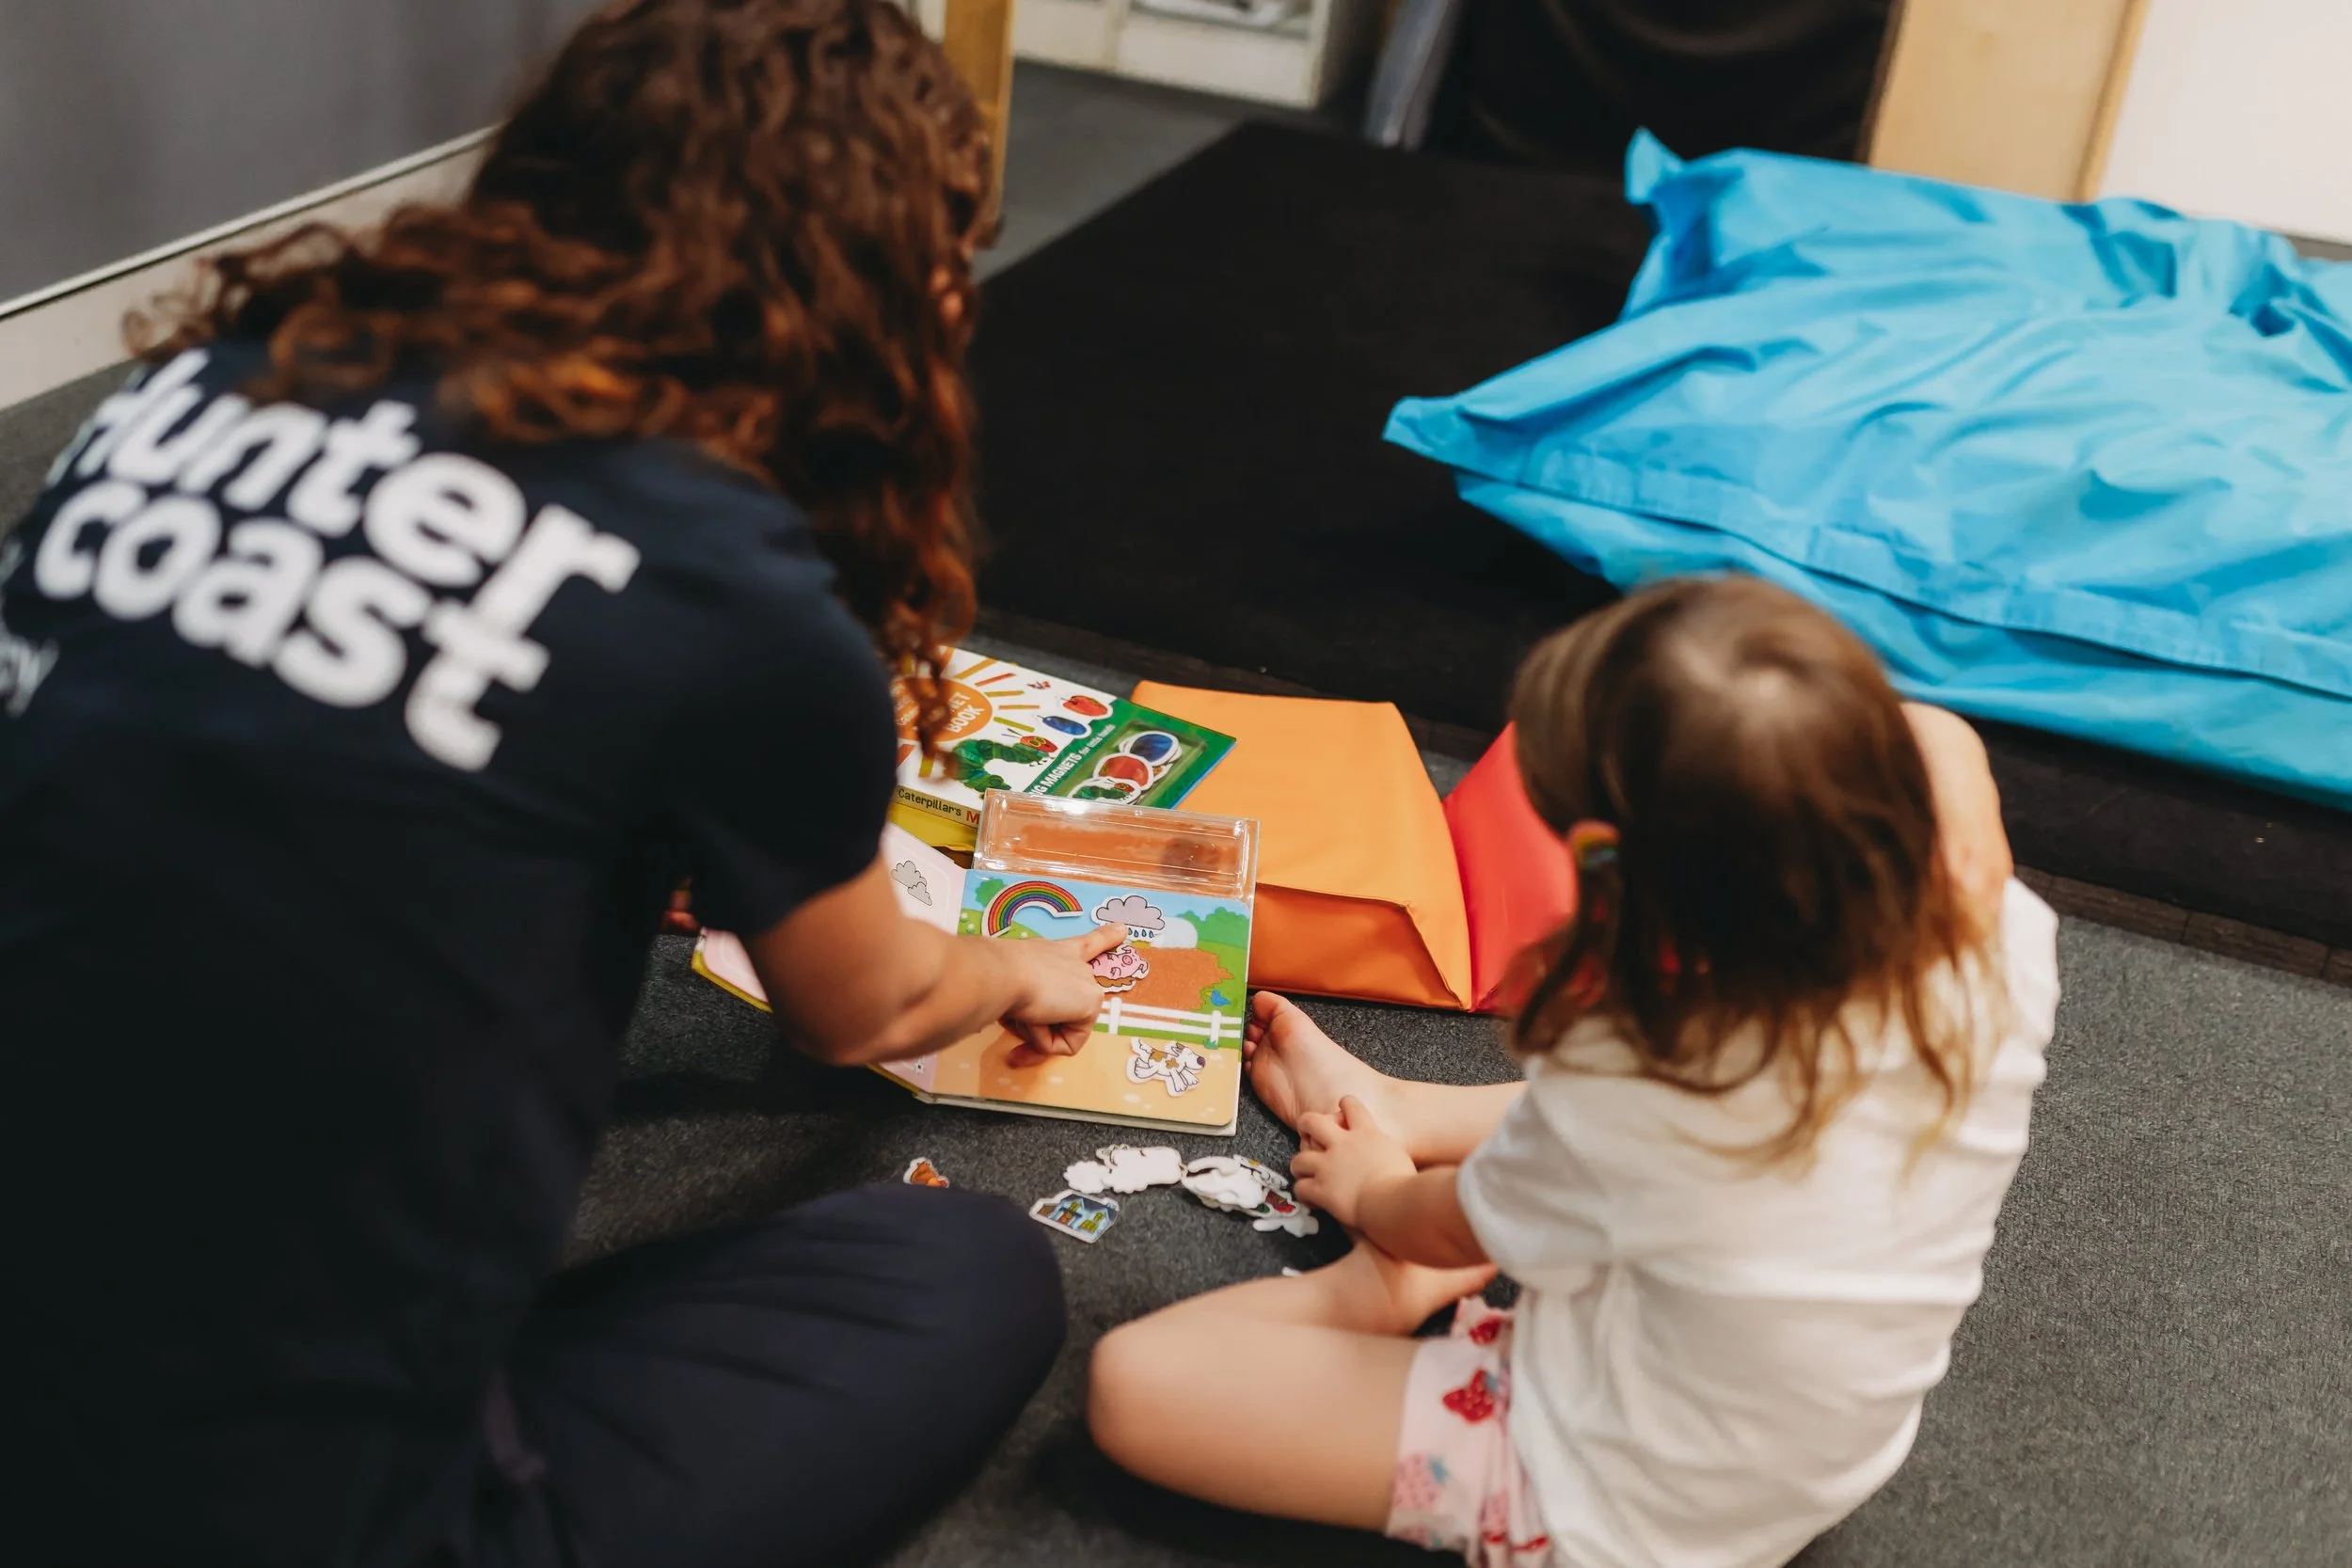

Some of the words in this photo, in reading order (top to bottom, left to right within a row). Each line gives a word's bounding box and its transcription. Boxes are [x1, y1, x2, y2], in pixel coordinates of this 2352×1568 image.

[34, 480, 551, 772] coast
[948, 691, 972, 713] NET
[1040, 752, 1083, 788] MAGNETS
[898, 787, 962, 817] Caterpillar's
